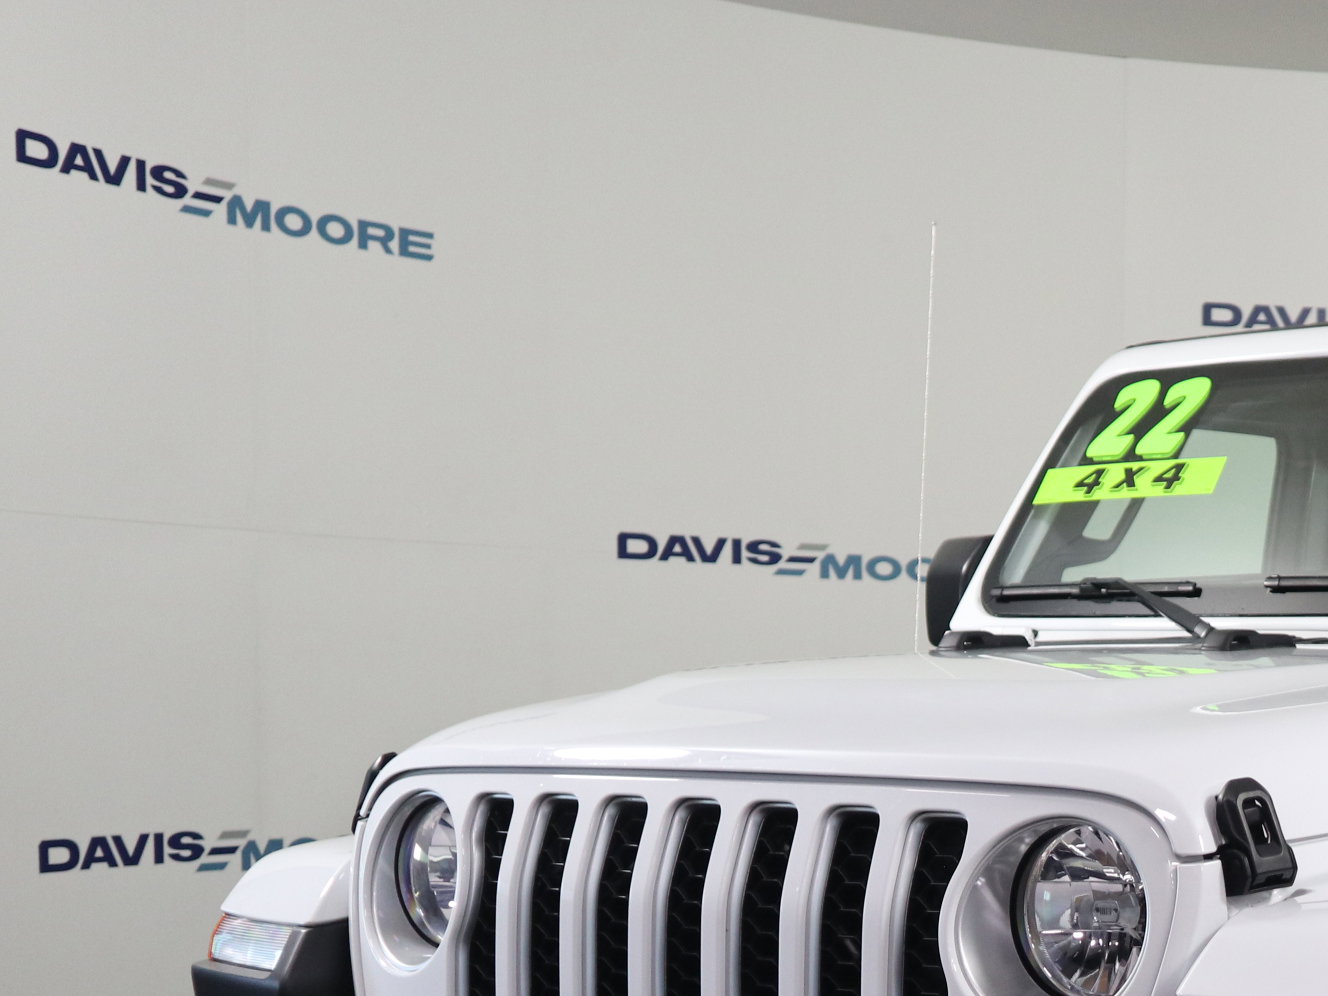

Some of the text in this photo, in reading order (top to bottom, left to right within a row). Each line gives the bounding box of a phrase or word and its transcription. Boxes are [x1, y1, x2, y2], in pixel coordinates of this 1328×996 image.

[15, 128, 435, 262] DAVIS MOORE
[1085, 376, 1213, 461] 22
[616, 531, 783, 566] DAVIS
[38, 830, 204, 874] DAVIS
